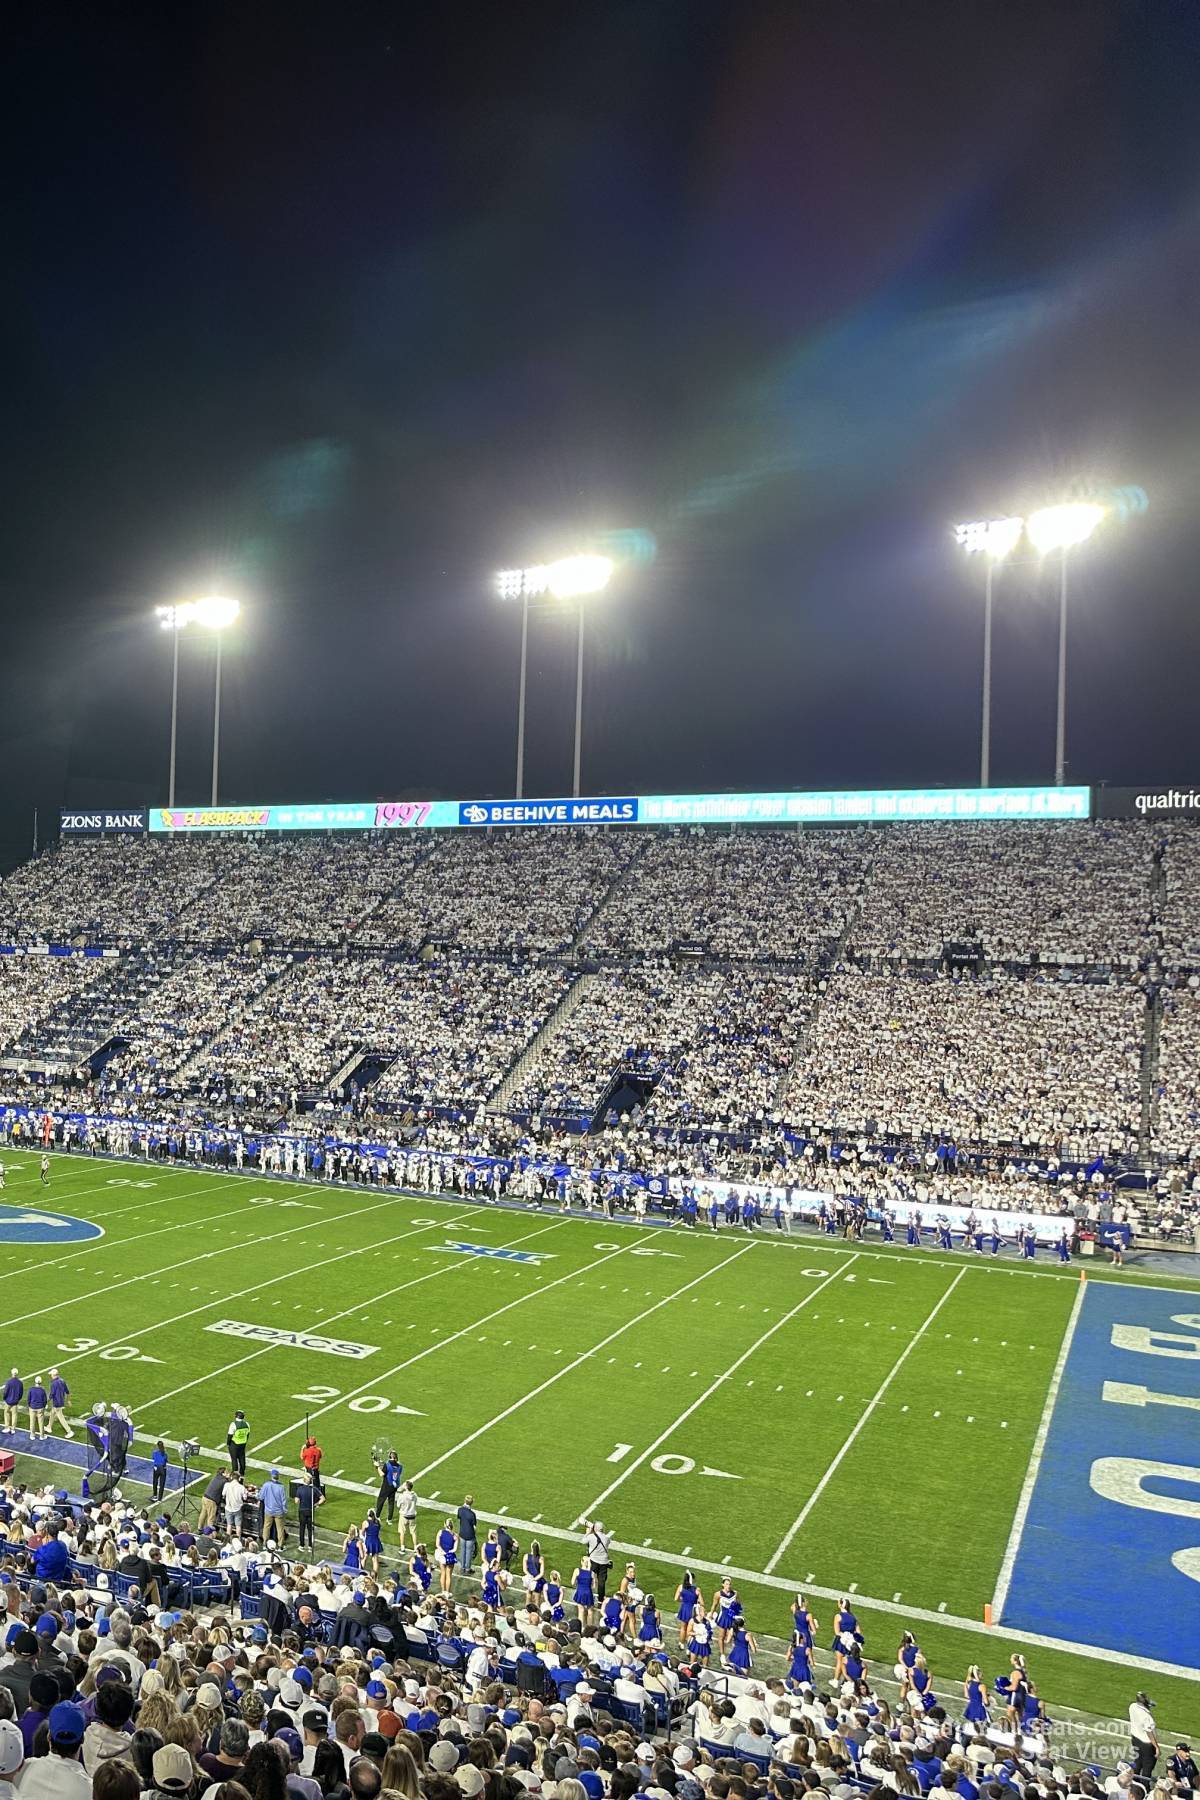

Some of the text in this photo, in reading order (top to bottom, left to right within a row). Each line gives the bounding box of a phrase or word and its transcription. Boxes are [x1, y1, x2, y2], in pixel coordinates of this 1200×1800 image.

[61, 815, 143, 828] ZIONS BANK
[184, 810, 267, 826] FLASHBACK
[327, 810, 366, 822] YEAR
[374, 802, 433, 826] 1997
[491, 803, 634, 822] BEEHIVE MEALS
[56, 1337, 141, 1360] 30
[242, 1325, 366, 1356] PACS
[291, 1385, 392, 1414] 20
[605, 1443, 697, 1476] 10
